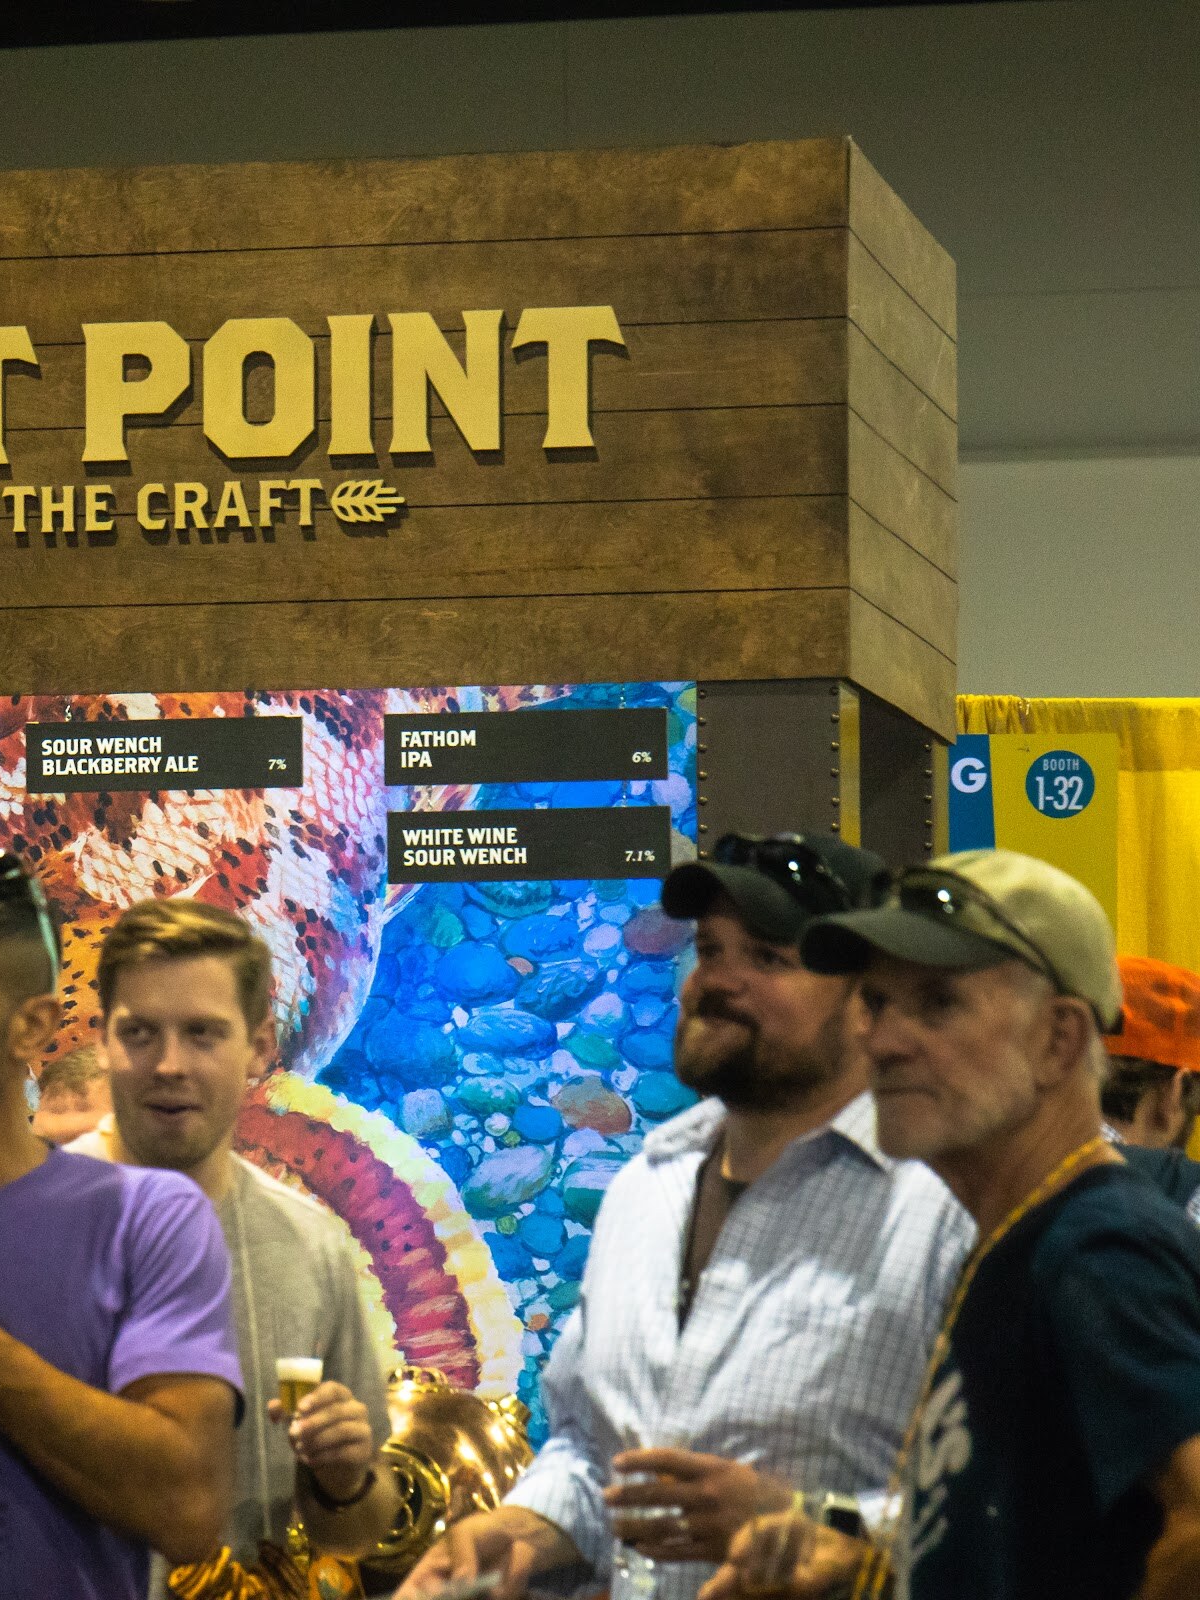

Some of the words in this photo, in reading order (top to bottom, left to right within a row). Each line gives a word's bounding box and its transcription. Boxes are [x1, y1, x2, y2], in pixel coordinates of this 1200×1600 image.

[81, 305, 628, 462] POINT
[2, 484, 115, 533] THE
[136, 478, 324, 531] CRAFT
[41, 738, 92, 756] SOUR
[96, 736, 162, 754] WENCH
[400, 730, 477, 748] FATHOM
[42, 757, 161, 776] BLACKBERRY
[164, 755, 199, 773] ALE
[268, 758, 287, 770] 7%
[401, 751, 433, 768] IPA
[631, 751, 652, 763] 6%
[1043, 759, 1080, 771] BOOTH
[951, 757, 987, 793] G
[1035, 776, 1084, 811] 1-32
[402, 829, 464, 846] WHITE
[467, 827, 518, 844] WINE
[403, 849, 456, 867] SOUR
[460, 847, 527, 865] WENCH
[625, 850, 656, 862] 7.1%
